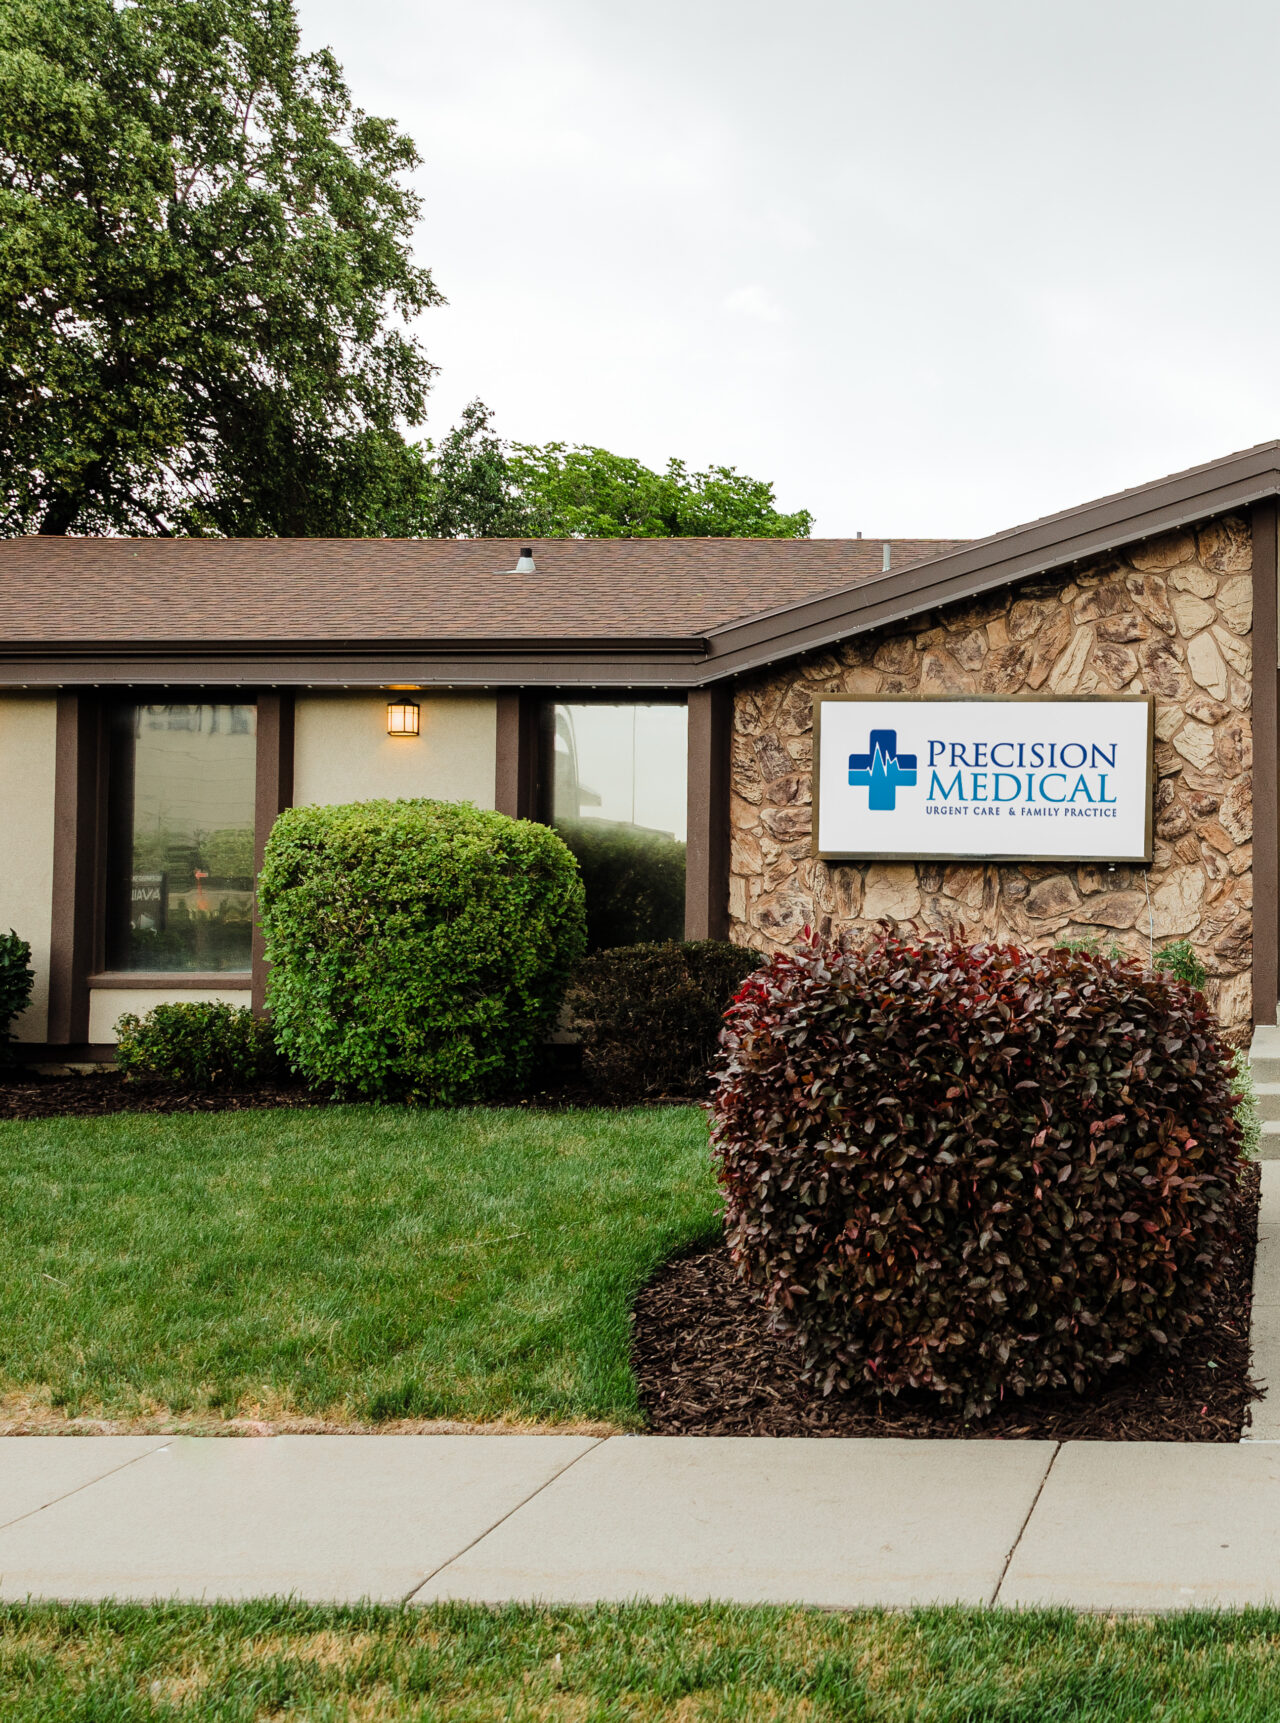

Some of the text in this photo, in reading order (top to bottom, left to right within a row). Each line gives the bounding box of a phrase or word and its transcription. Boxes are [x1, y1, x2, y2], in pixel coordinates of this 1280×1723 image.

[927, 740, 1118, 768] PRECISION
[926, 770, 1117, 803] MEDICAL
[926, 806, 1117, 818] URGENT CARE & FAMILY PRACTICE
